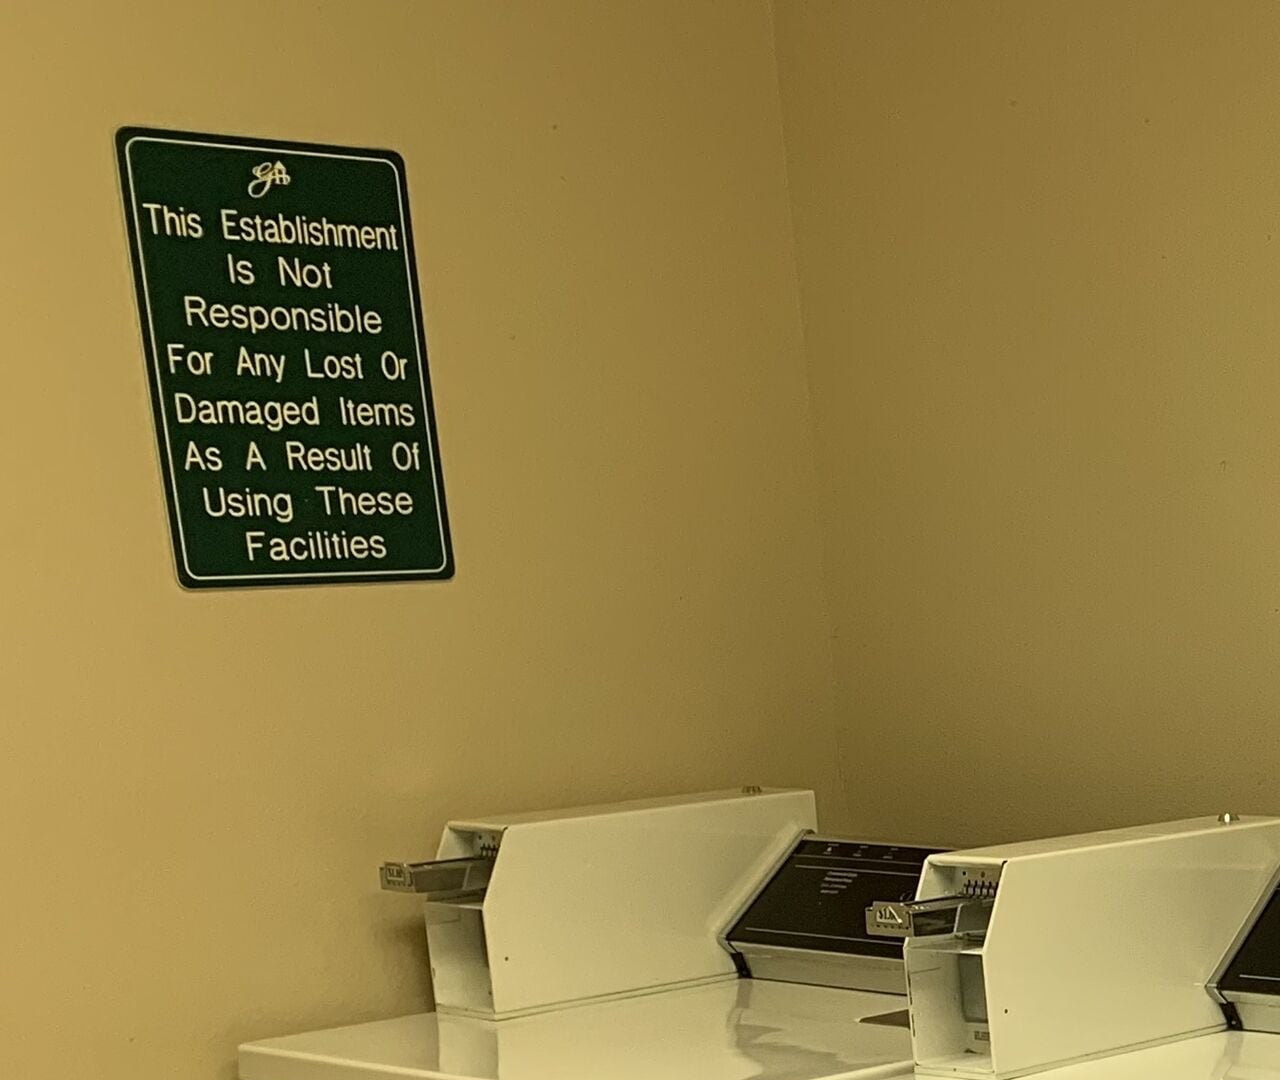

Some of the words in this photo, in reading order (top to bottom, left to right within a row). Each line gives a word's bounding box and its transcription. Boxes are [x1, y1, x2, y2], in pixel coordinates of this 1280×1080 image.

[143, 203, 202, 238] This
[221, 208, 399, 251] Establishment
[228, 254, 254, 284] Is
[278, 257, 332, 288] Not
[184, 296, 382, 334] Responsible
[167, 344, 214, 376] For
[237, 347, 286, 382] Any
[305, 349, 364, 380] Lost
[382, 351, 408, 380] Or
[175, 393, 320, 432] Damaged
[340, 397, 416, 426] Items
[185, 441, 222, 470] As
[246, 442, 266, 470] A
[286, 441, 372, 472] Result
[392, 442, 420, 470] Of
[203, 488, 294, 522] Using
[315, 487, 412, 516] These
[246, 532, 386, 560] Facilities
